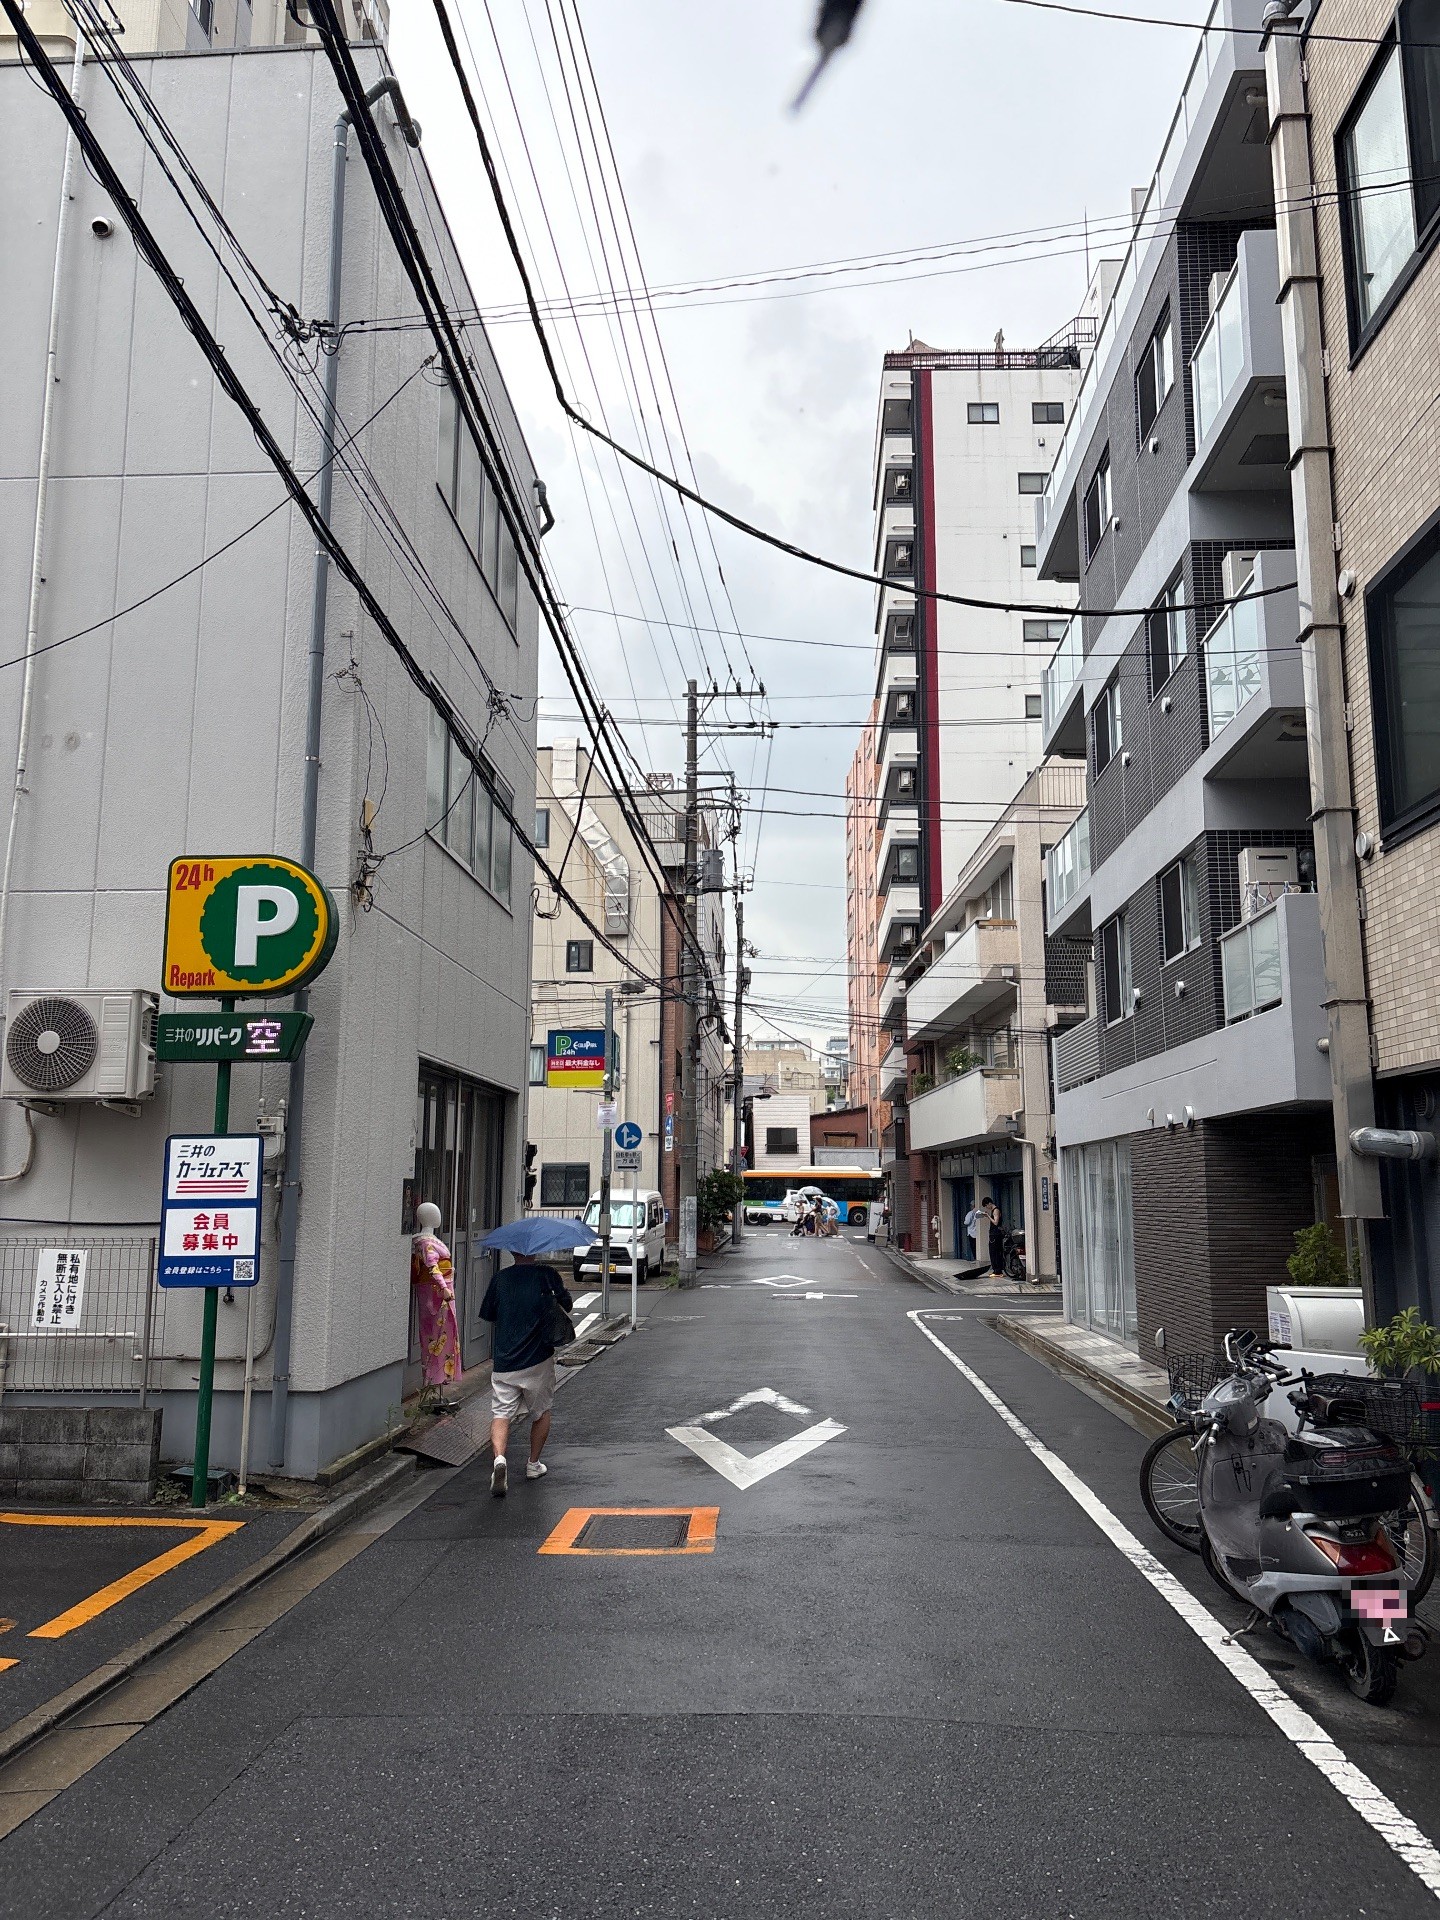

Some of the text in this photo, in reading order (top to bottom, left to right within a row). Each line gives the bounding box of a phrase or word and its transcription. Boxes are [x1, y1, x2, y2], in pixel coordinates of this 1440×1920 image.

[175, 864, 214, 890] 24h
[234, 885, 299, 966] P
[170, 964, 215, 989] Repark
[165, 1026, 242, 1046] 三井のリパーク
[245, 1019, 282, 1054] 空
[555, 1035, 572, 1056] P
[564, 1059, 601, 1067] 最大料金なし
[177, 1145, 216, 1158] 三井の
[176, 1160, 250, 1178] カーシェアーズ
[193, 1213, 230, 1231] 会員
[182, 1233, 239, 1251] 募集中
[163, 1265, 223, 1275] 会員登録はこちら
[50, 1253, 68, 1325] 無断立入り禁止
[65, 1253, 81, 1315] 私有地に付き
[36, 1279, 48, 1324] カメラ作動中
